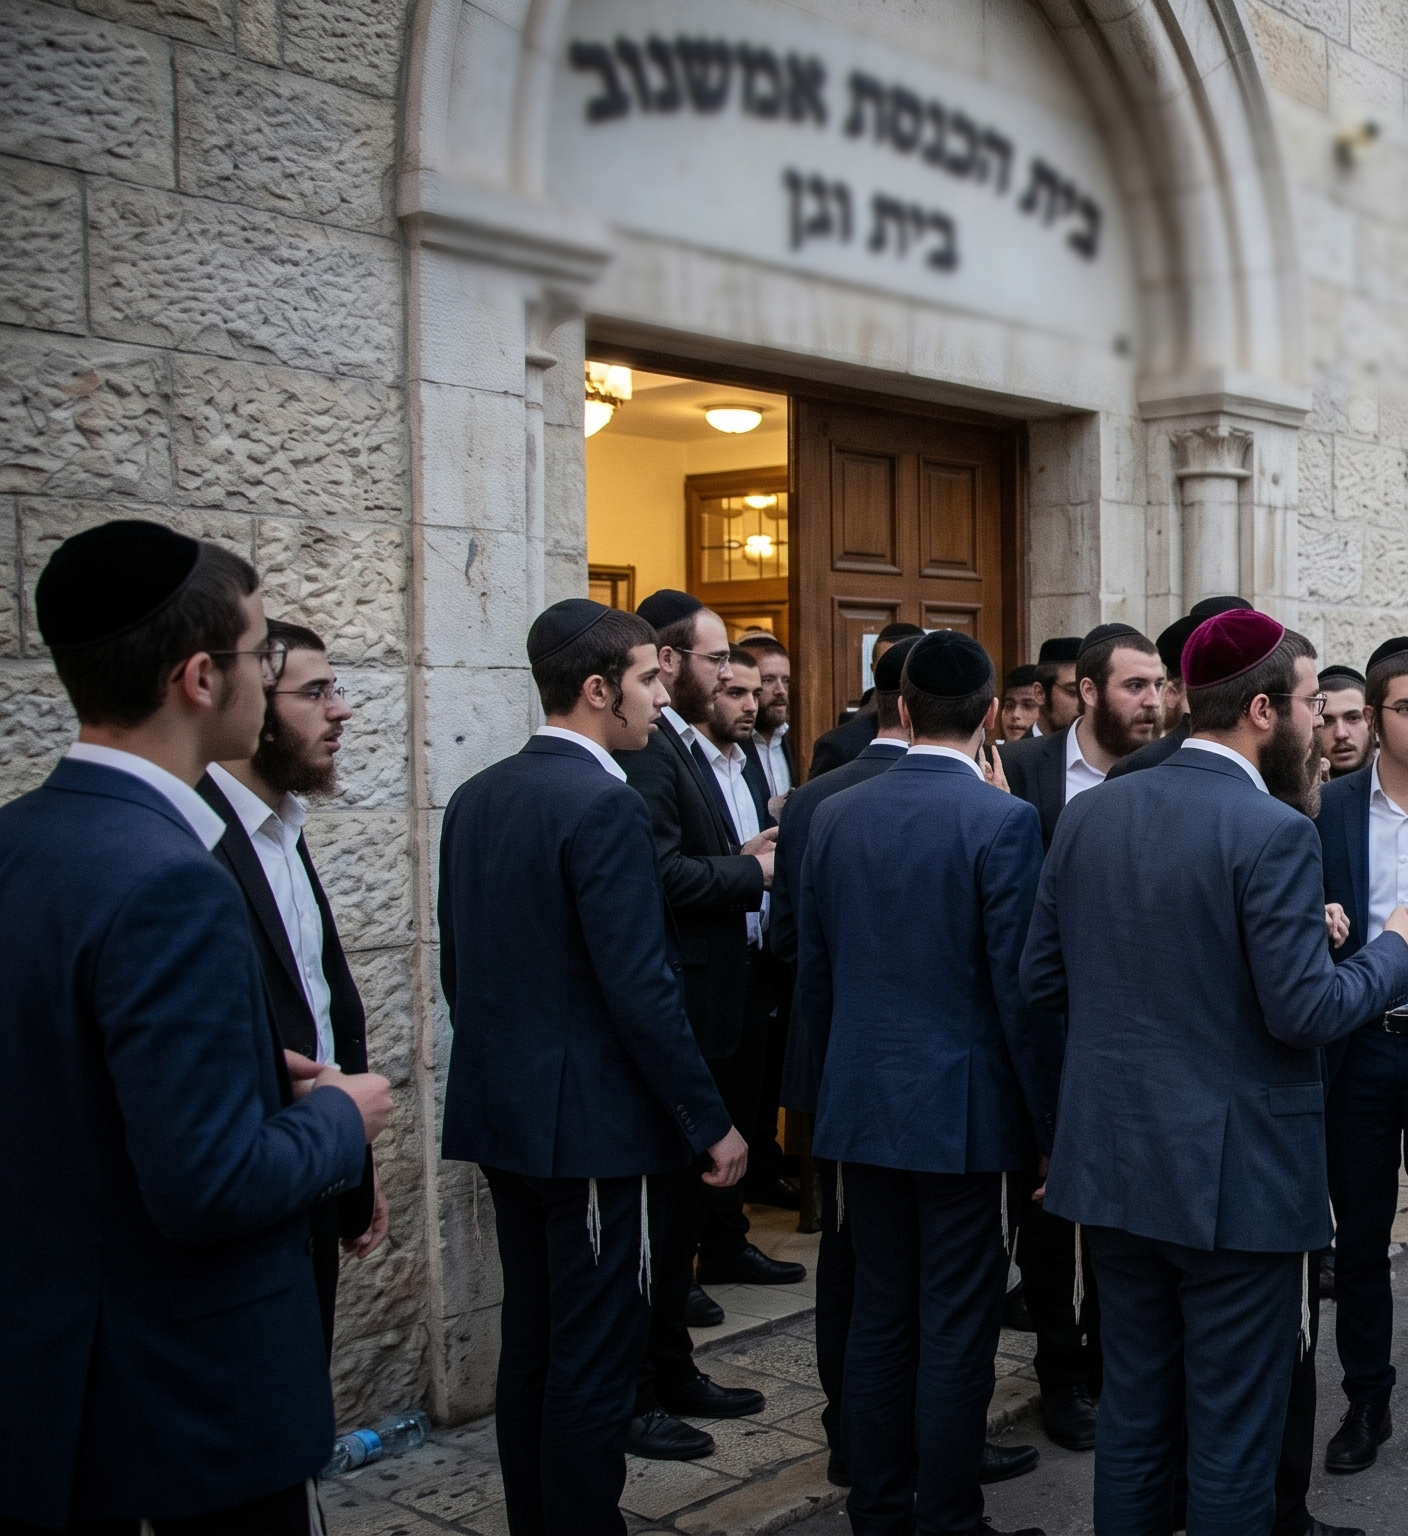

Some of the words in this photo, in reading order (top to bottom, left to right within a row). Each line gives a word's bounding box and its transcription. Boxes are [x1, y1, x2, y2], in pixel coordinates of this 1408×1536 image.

[568, 37, 825, 124] אמשנוב
[845, 71, 1013, 193] הכנסת
[784, 168, 852, 250] וגן
[868, 193, 959, 274] בית
[1019, 160, 1101, 259] בית
